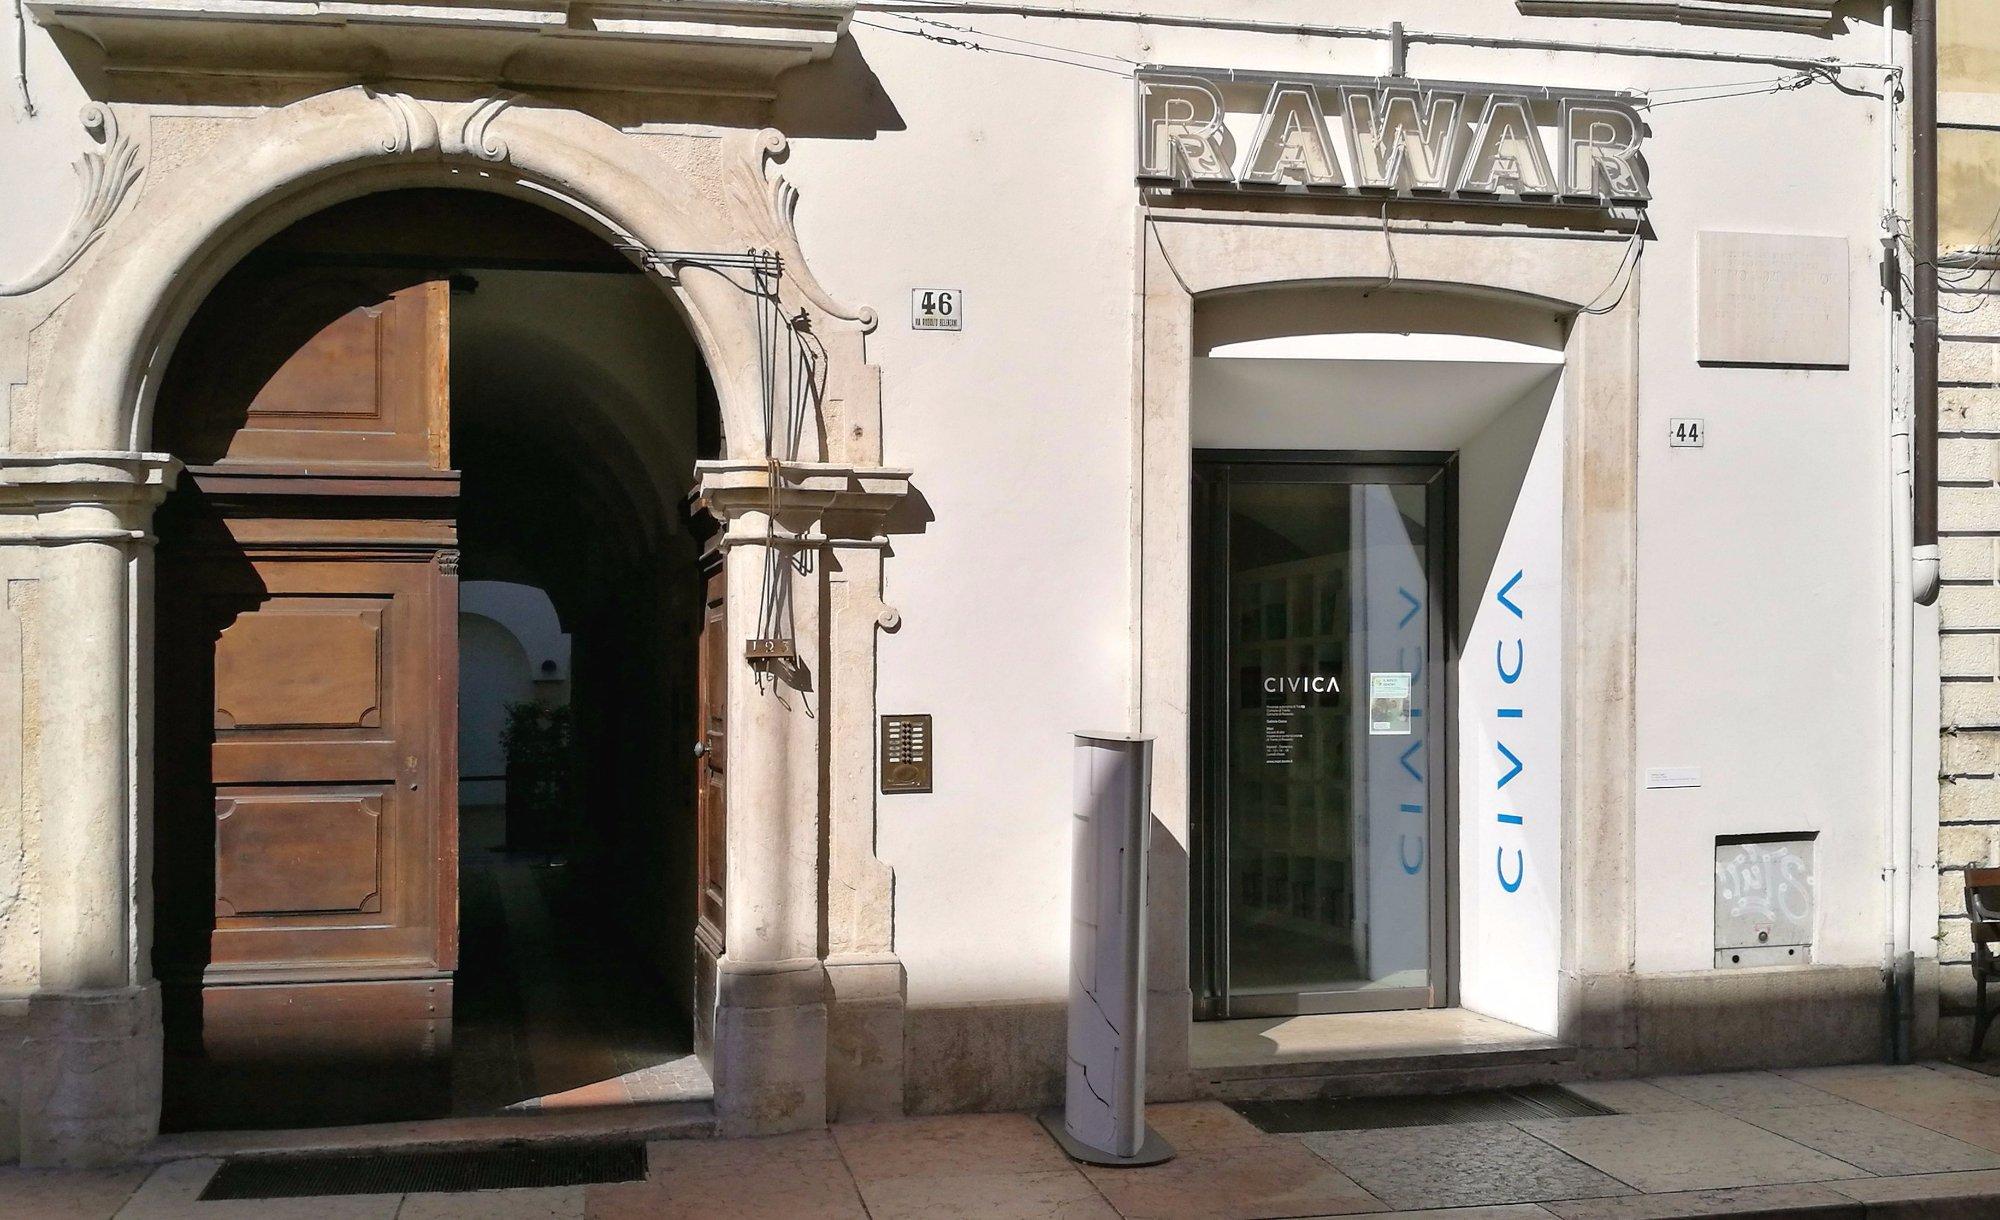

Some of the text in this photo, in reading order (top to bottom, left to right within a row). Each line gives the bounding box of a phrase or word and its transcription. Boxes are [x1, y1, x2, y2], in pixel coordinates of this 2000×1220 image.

[1135, 72, 1652, 202] RAWAR
[922, 292, 952, 315] 46
[1676, 423, 1699, 442] 44
[1263, 676, 1340, 693] CIVICA
[1497, 569, 1524, 893] CIVICA
